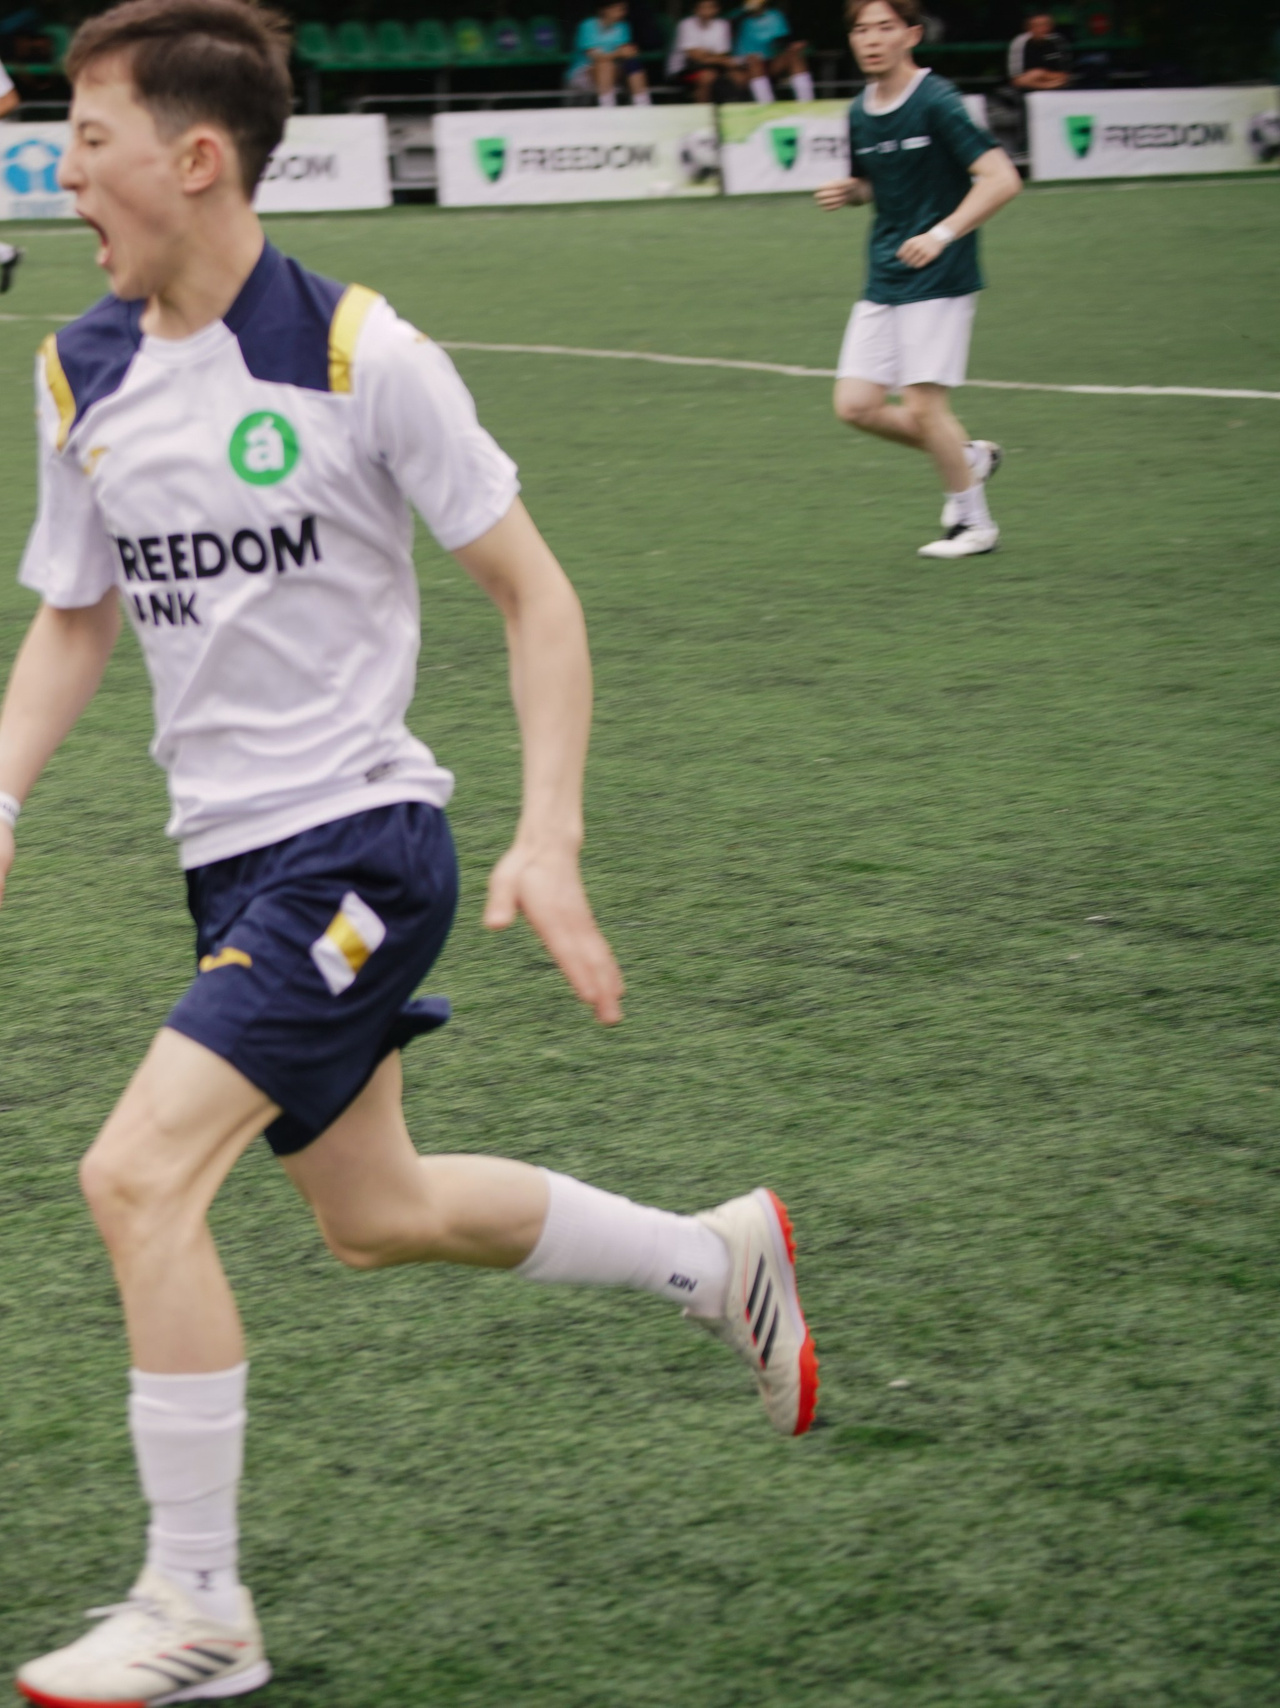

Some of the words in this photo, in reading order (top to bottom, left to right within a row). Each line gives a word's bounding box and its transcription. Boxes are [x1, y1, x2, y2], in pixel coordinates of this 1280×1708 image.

[1104, 122, 1230, 150] FREEDOM
[518, 144, 657, 173] FREEDOM
[110, 514, 324, 583] REEDOM
